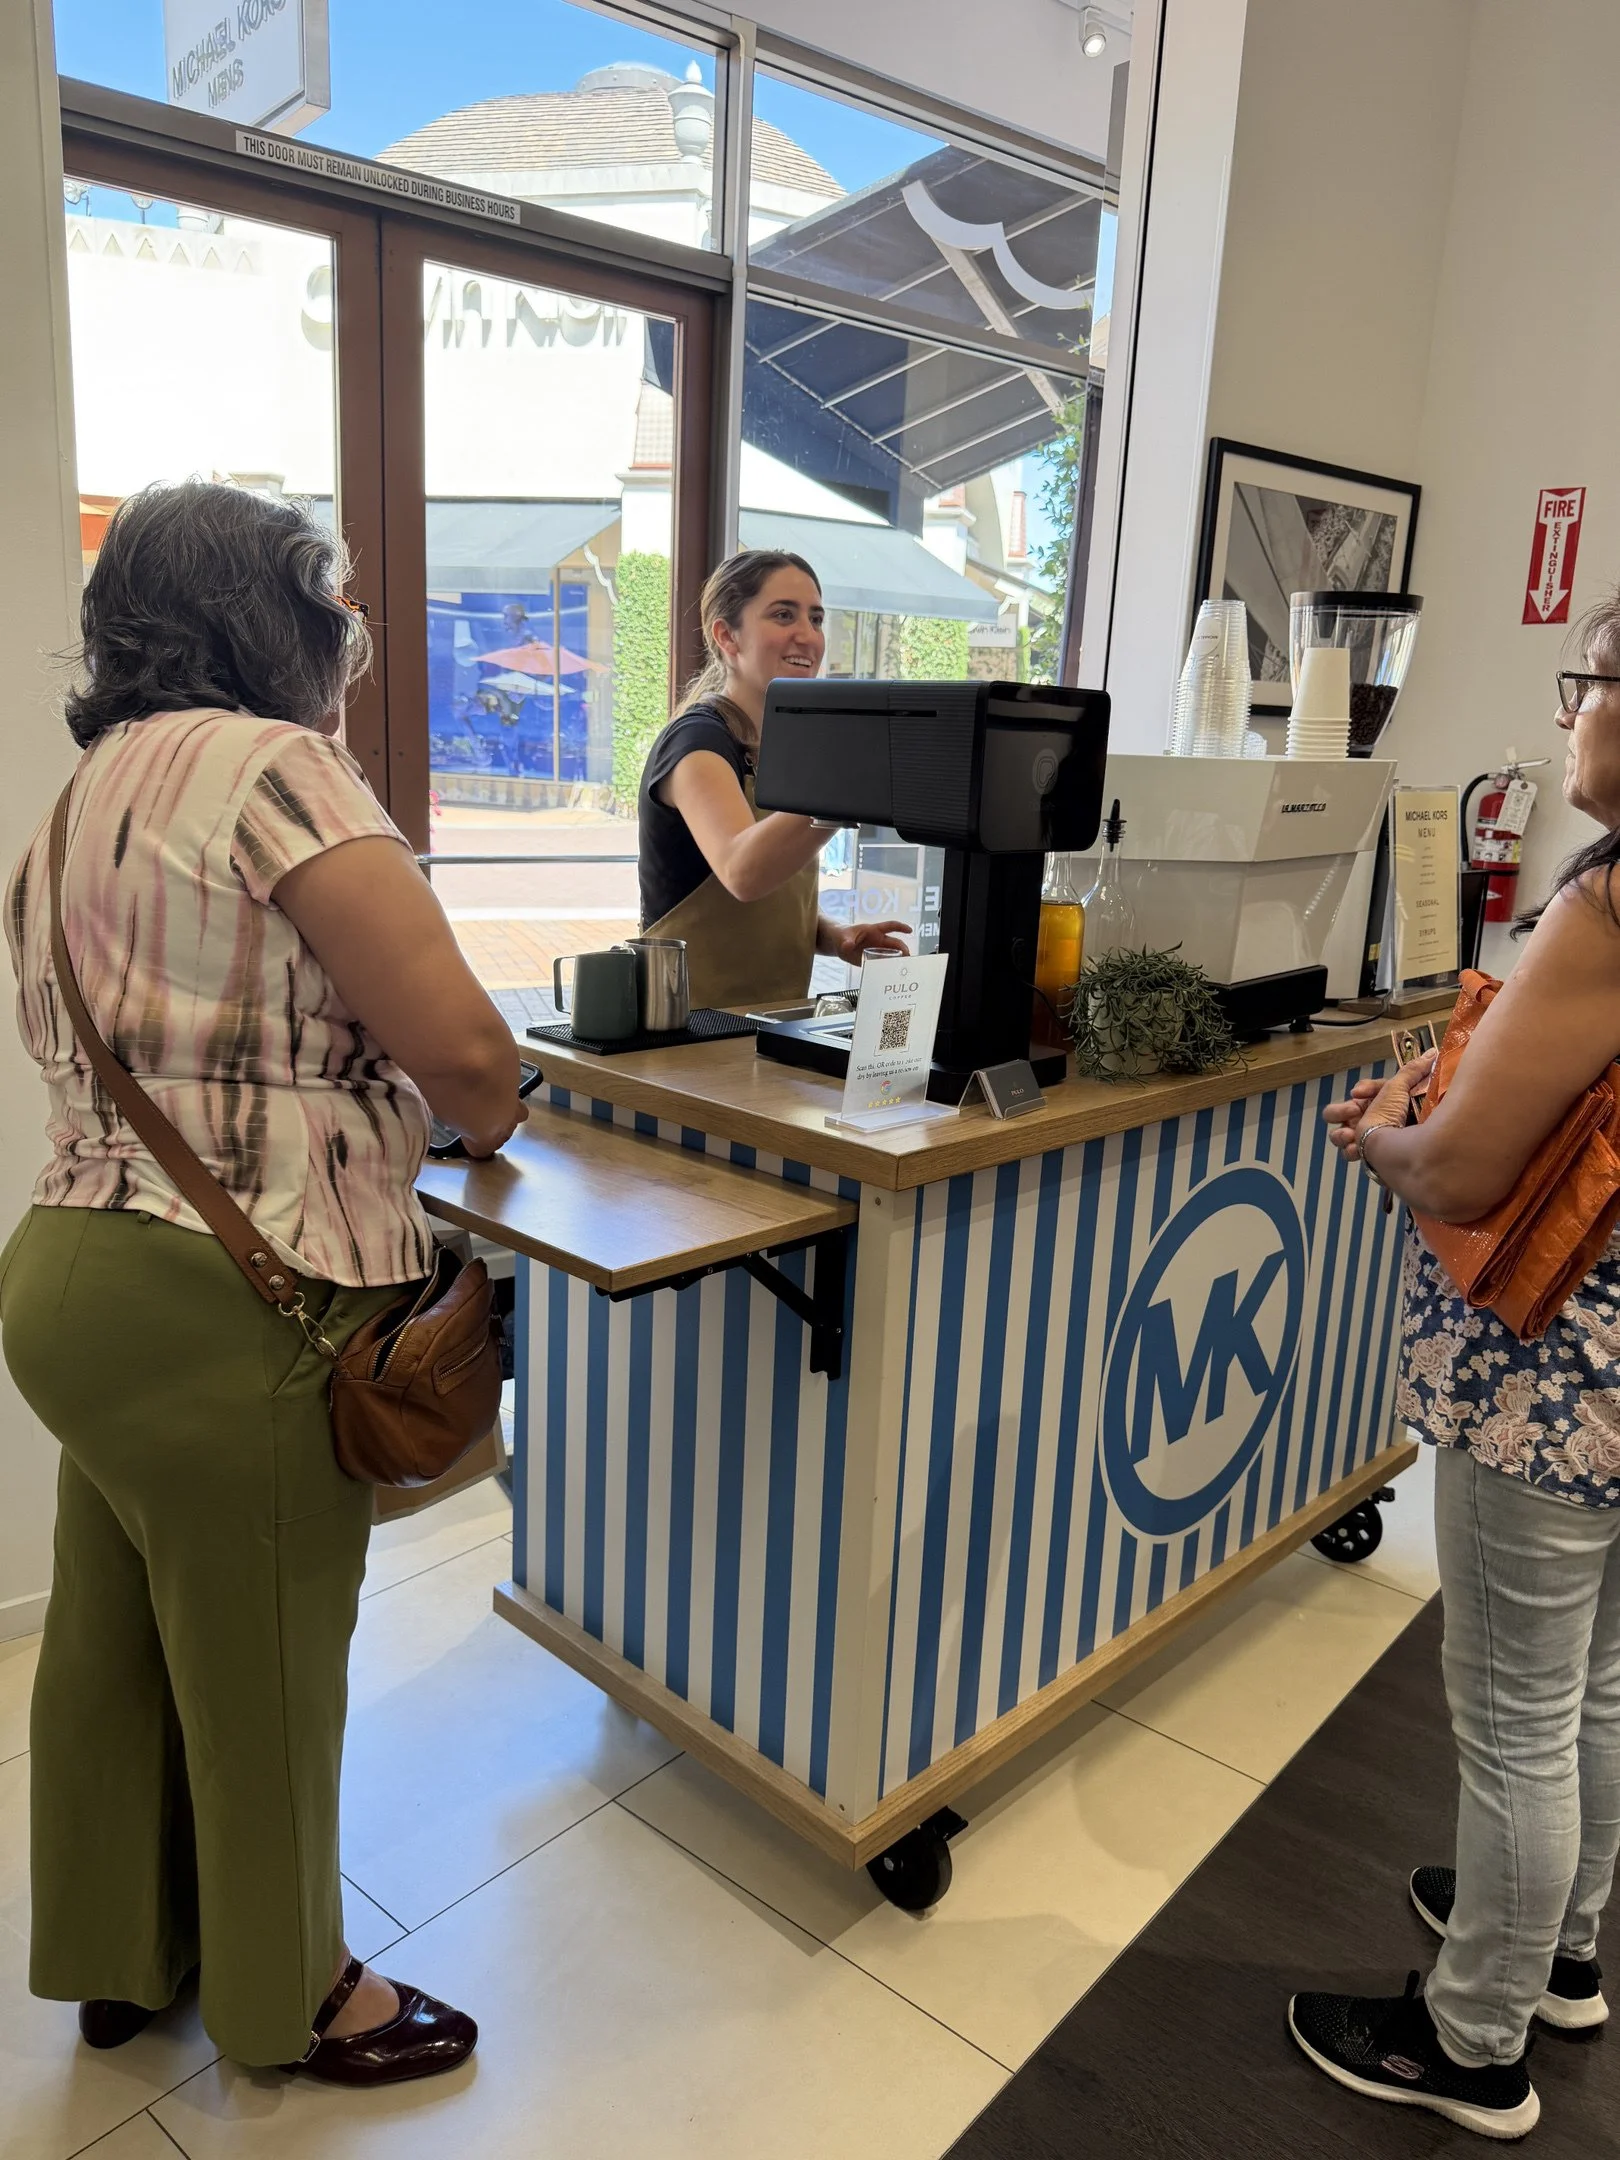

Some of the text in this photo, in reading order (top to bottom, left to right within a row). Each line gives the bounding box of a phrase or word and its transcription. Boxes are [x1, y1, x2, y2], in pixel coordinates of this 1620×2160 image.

[172, 17, 236, 100] MICHAEL
[207, 58, 244, 109] MENS
[243, 136, 515, 220] THIS DOOR MUST REMAIN UNLOCKED DURING BUSINESS HOURS
[1544, 500, 1576, 518] FIRE
[1542, 521, 1562, 612] EXTINGUISHER
[1405, 810, 1448, 821] MICHAEL KORS
[1418, 828, 1436, 838] MENU
[884, 982, 919, 994] PULO
[1131, 1248, 1287, 1466] MK
